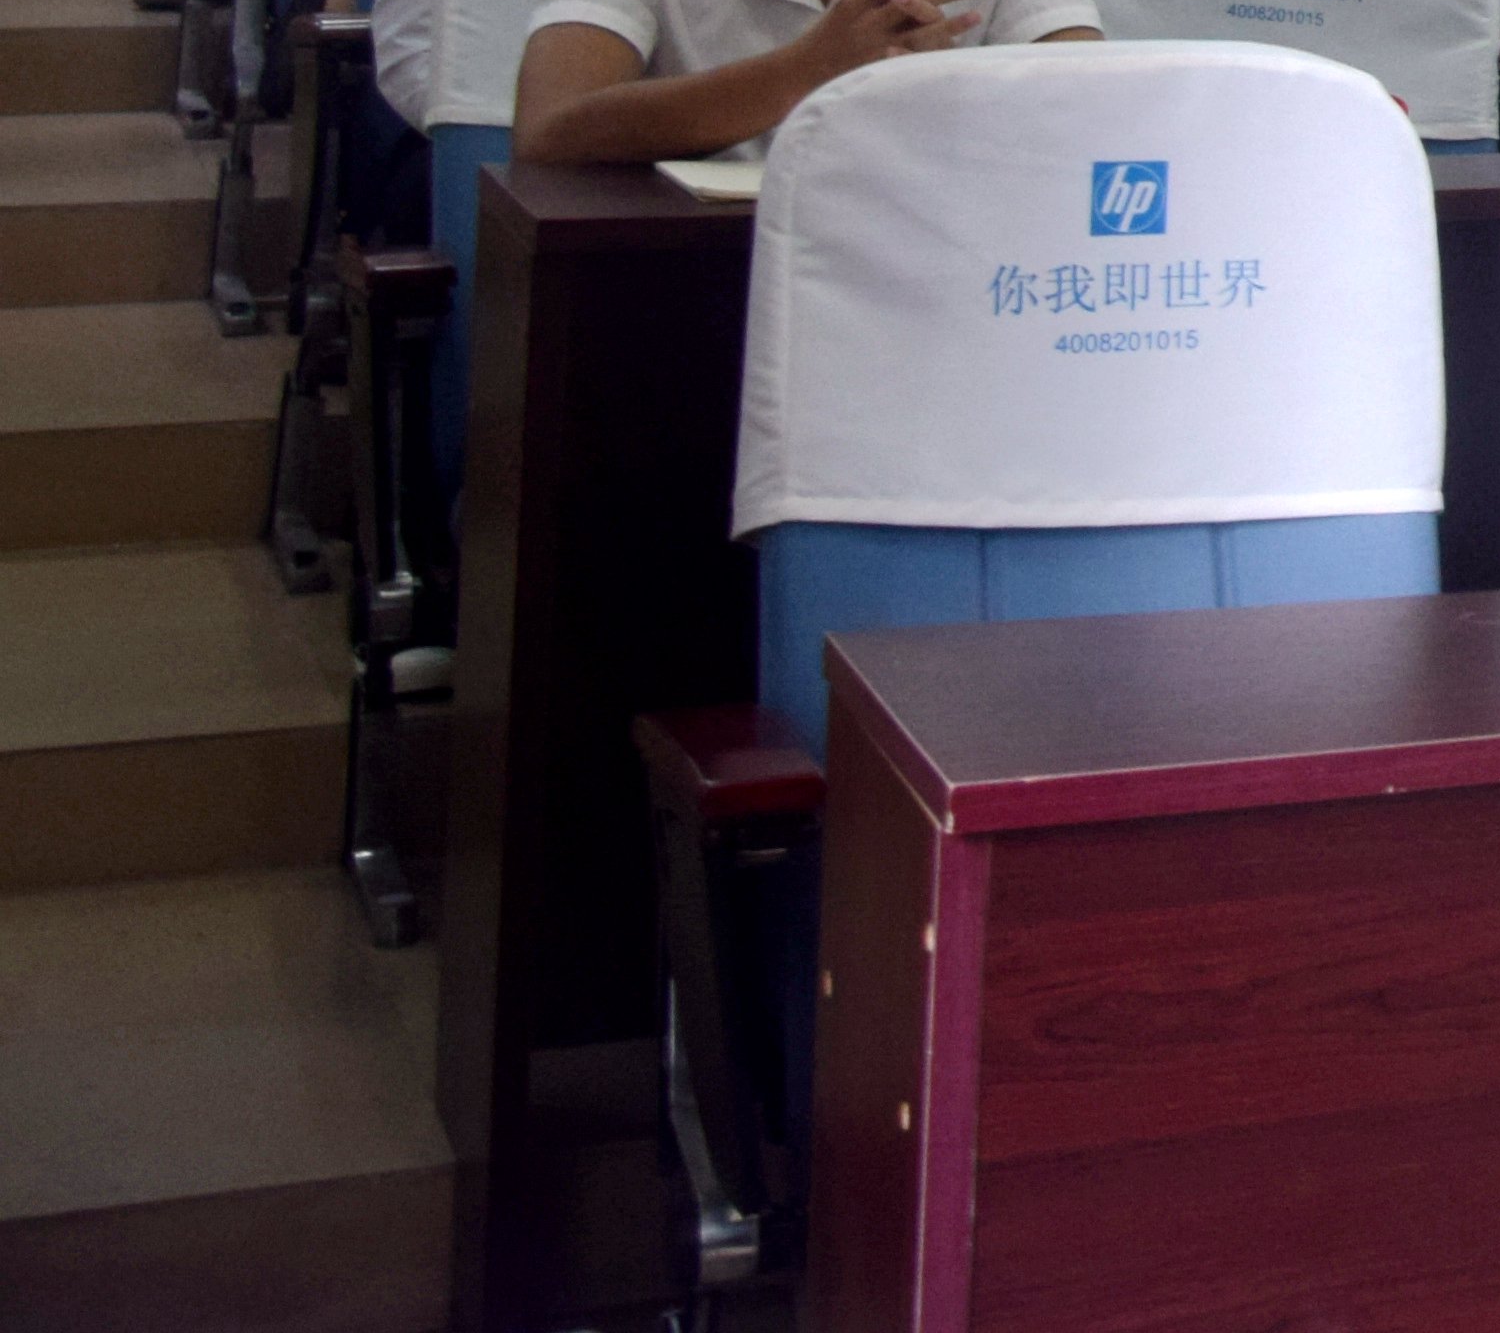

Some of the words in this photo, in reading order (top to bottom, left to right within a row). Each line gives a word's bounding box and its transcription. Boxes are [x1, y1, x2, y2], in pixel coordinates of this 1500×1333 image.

[1226, 4, 1326, 26] 4008201015
[1100, 163, 1155, 234] hp
[987, 259, 1267, 316] 你我即世界
[1054, 329, 1200, 354] 4008201015
